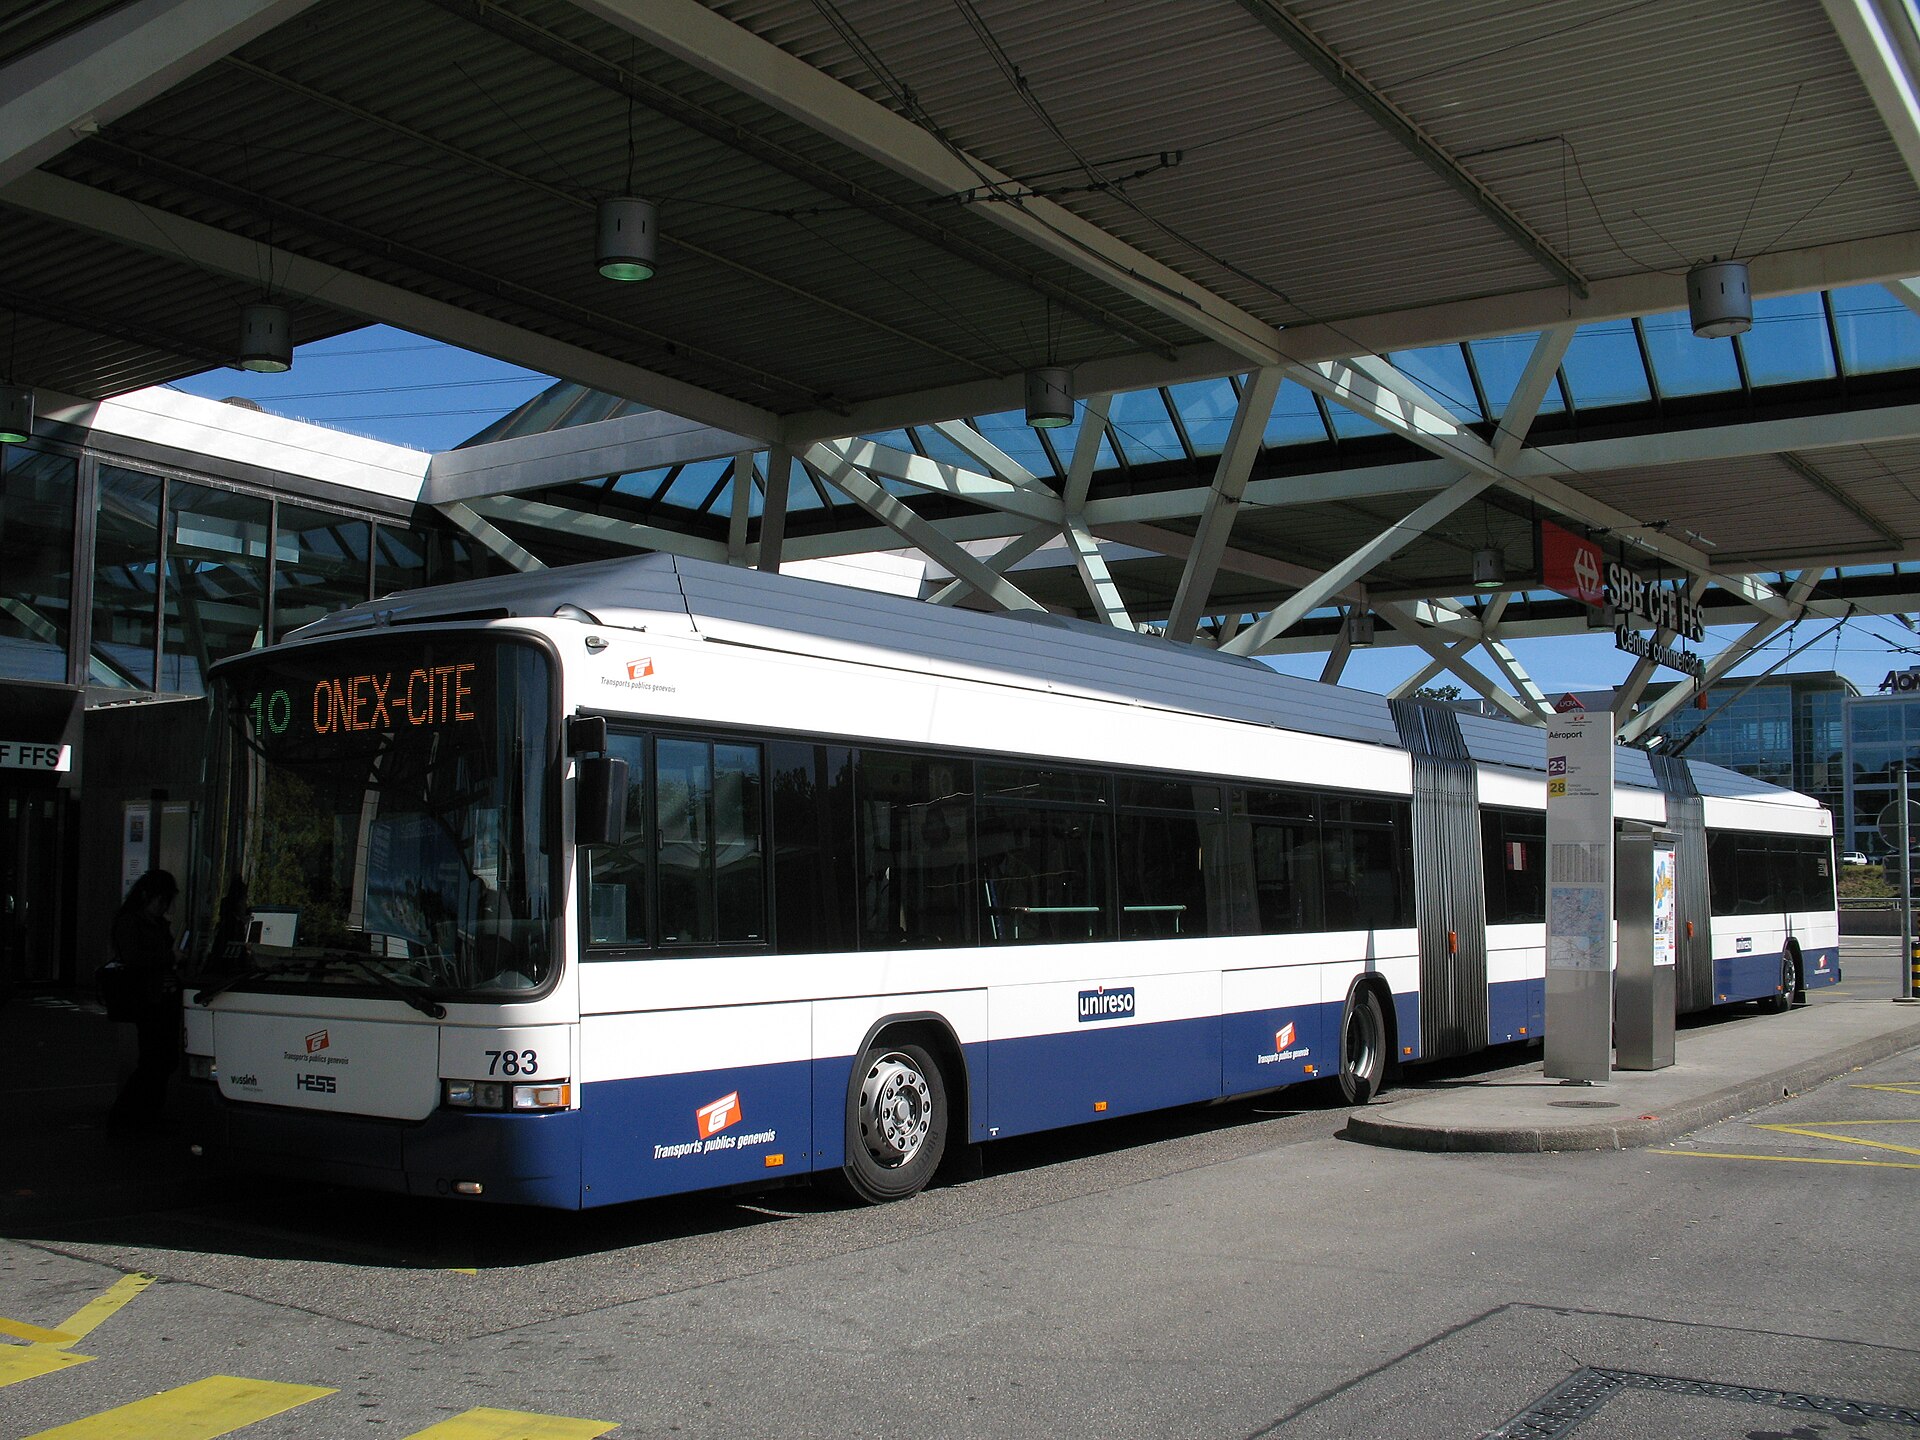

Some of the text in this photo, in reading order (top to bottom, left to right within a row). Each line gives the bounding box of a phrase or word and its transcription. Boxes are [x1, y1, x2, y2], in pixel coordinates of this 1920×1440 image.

[1609, 562, 1645, 616] SBB
[1681, 596, 1705, 643] FFS
[1620, 624, 1650, 658] Centre
[601, 676, 676, 693] Transports publics genevois
[249, 663, 475, 736] 10 ONEX-CITE
[1548, 731, 1583, 740] Aéroport
[19, 745, 60, 768] FFS
[1549, 760, 1566, 772] 23
[1550, 782, 1566, 793] 28
[1079, 986, 1134, 1016] unireso
[283, 1051, 349, 1066] Transports publics genevois
[484, 1049, 539, 1076] 783
[297, 1073, 337, 1094] HESS
[653, 1128, 777, 1160] Transports publics genevois
